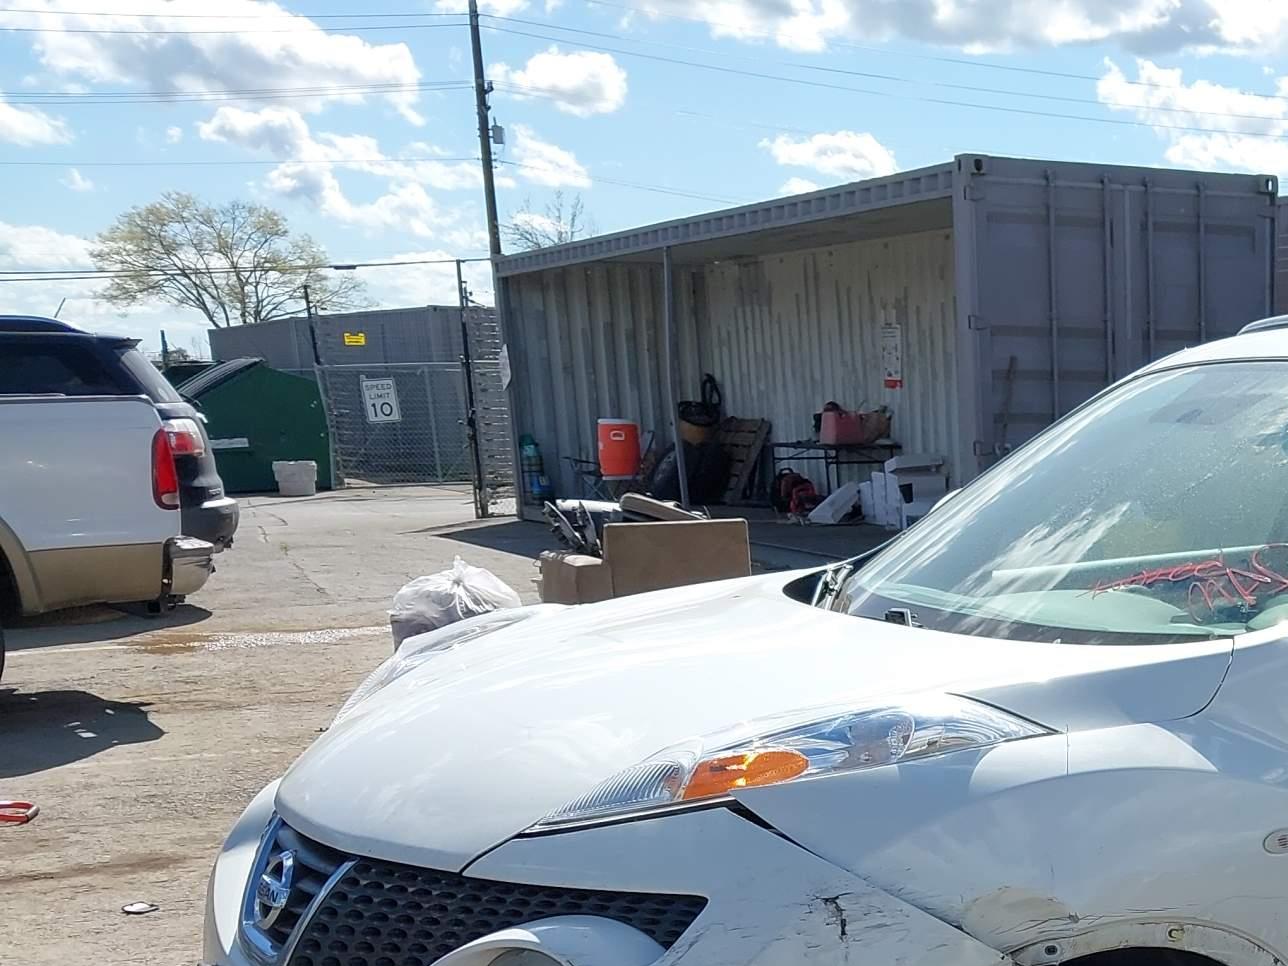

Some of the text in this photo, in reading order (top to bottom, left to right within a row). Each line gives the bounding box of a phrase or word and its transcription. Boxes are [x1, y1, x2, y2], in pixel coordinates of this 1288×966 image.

[365, 383, 392, 391] SPEED
[368, 392, 391, 400] LIMIT
[371, 402, 393, 418] 10
